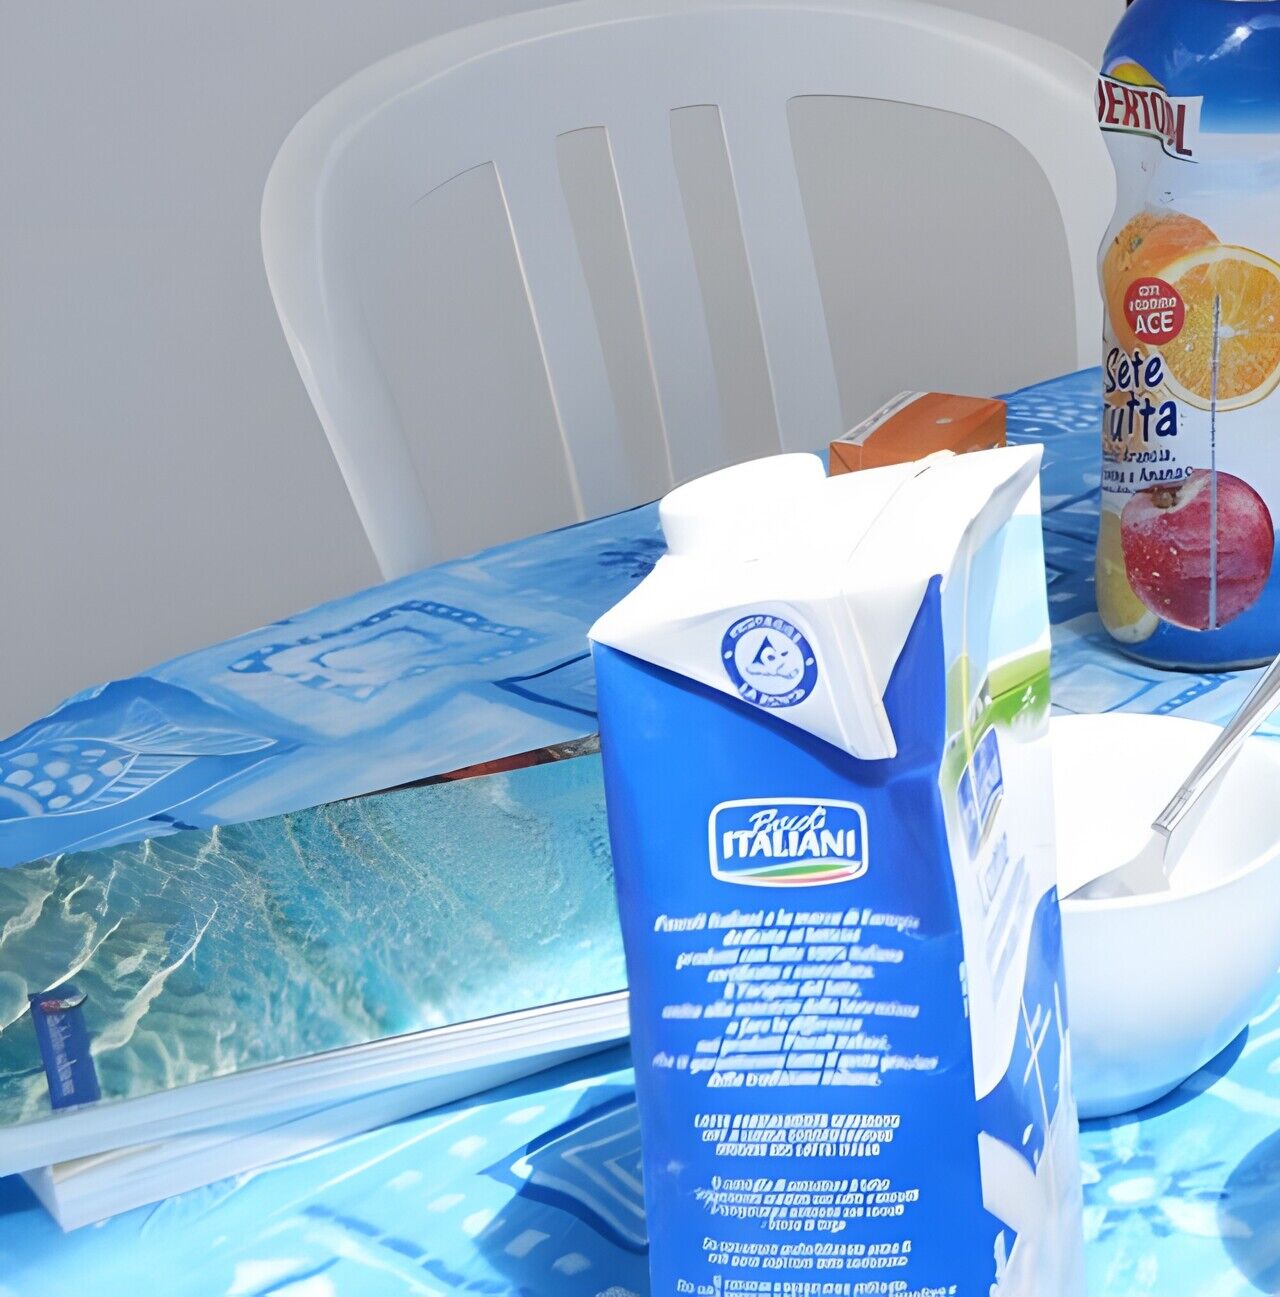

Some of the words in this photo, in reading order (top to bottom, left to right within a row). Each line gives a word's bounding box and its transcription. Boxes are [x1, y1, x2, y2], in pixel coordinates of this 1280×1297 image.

[1134, 310, 1175, 335] ACE
[1105, 347, 1165, 394] Sete
[722, 829, 856, 859] ITALIANI
